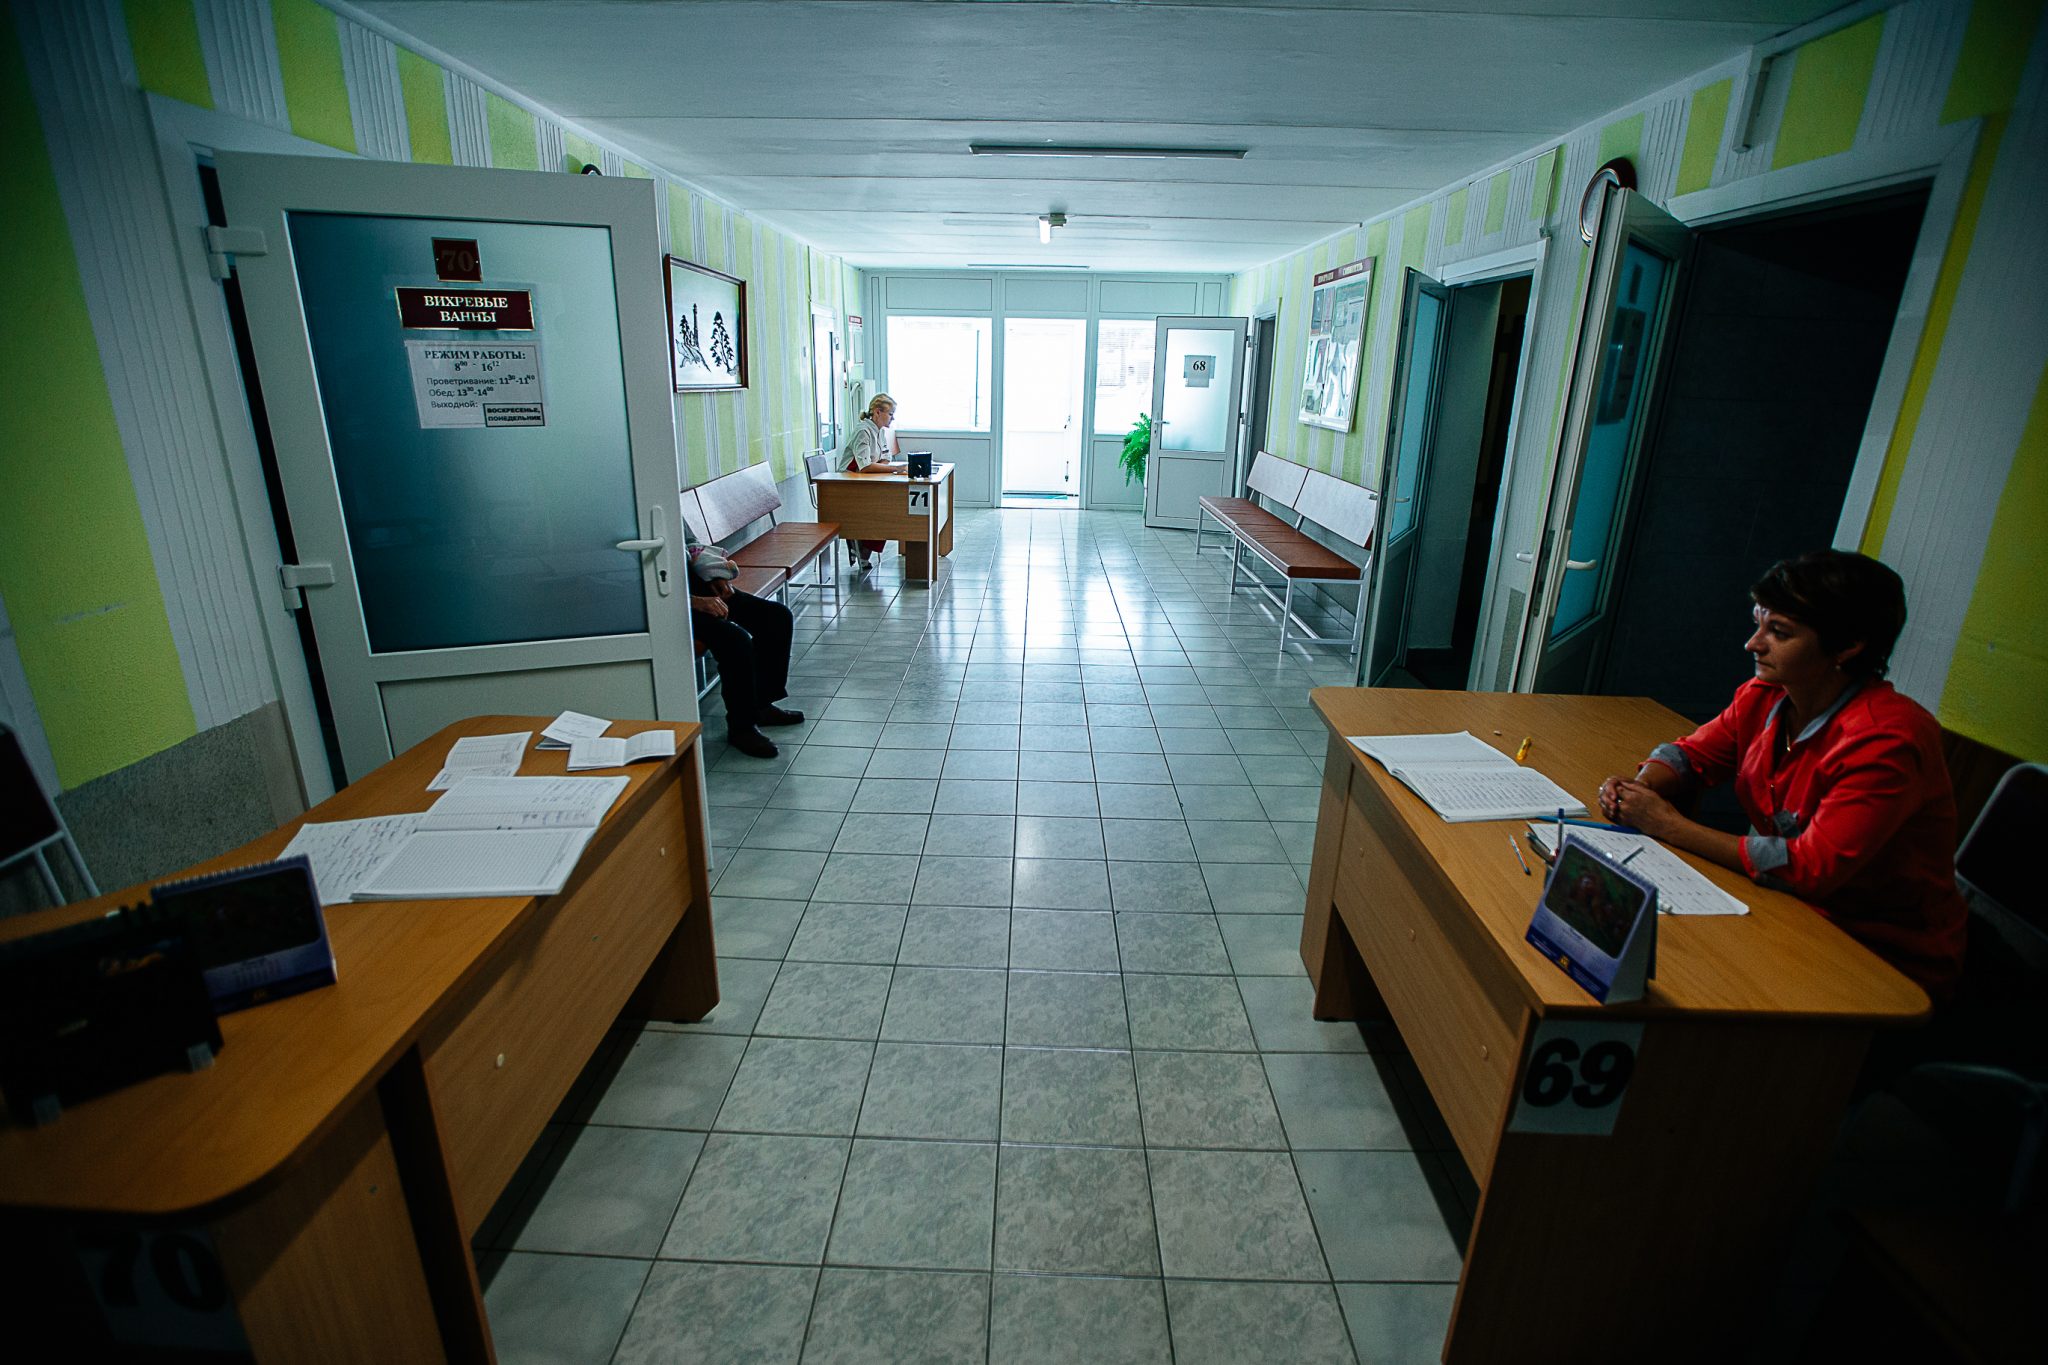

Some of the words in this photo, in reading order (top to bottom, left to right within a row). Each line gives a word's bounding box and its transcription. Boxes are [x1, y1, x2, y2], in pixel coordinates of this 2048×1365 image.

[441, 249, 474, 272] 70
[424, 295, 508, 308] ВИХРЕВЫЕ
[440, 310, 497, 323] ВАННЫ
[424, 350, 470, 360] РЕЖИМ
[473, 350, 526, 360] РАБОТЫ:
[1193, 360, 1206, 371] 68
[426, 377, 498, 387] Проветривание:
[428, 388, 455, 397] Обед:
[431, 401, 479, 409] Выходной:
[909, 491, 929, 507] 71
[1523, 1038, 1635, 1109] 69
[79, 1232, 229, 1311] 70
